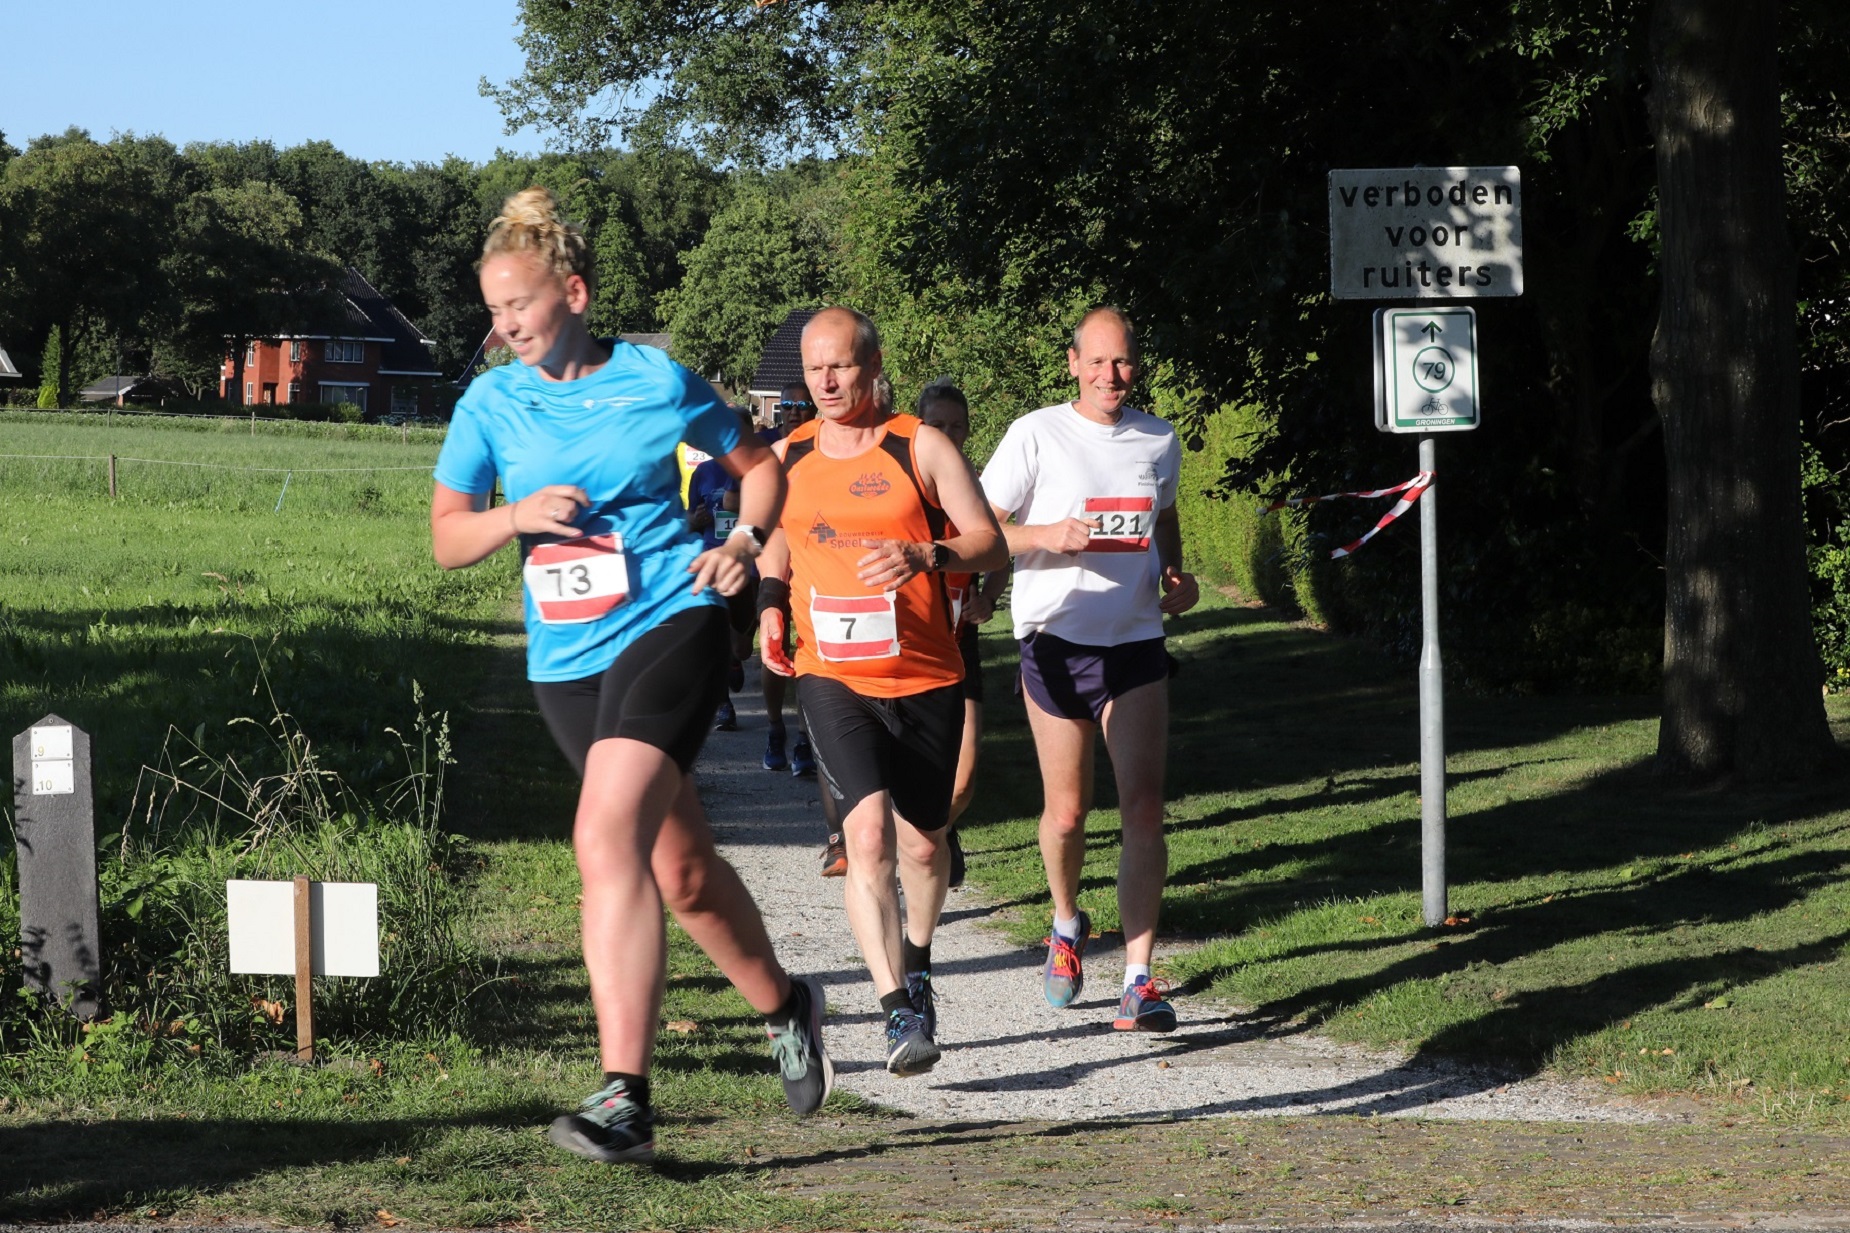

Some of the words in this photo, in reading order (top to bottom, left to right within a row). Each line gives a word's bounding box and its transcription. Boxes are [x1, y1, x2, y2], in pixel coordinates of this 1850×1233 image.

[1339, 180, 1513, 207] verboden
[1385, 225, 1469, 247] voor
[1363, 260, 1492, 288] ruiters
[1423, 361, 1446, 380] 79
[1415, 418, 1456, 426] GRONINGEN
[692, 452, 706, 461] 23
[1093, 513, 1143, 536] 121
[546, 564, 592, 597] 73
[839, 617, 857, 640] 7
[37, 746, 45, 757] 9
[39, 779, 53, 791] 10
